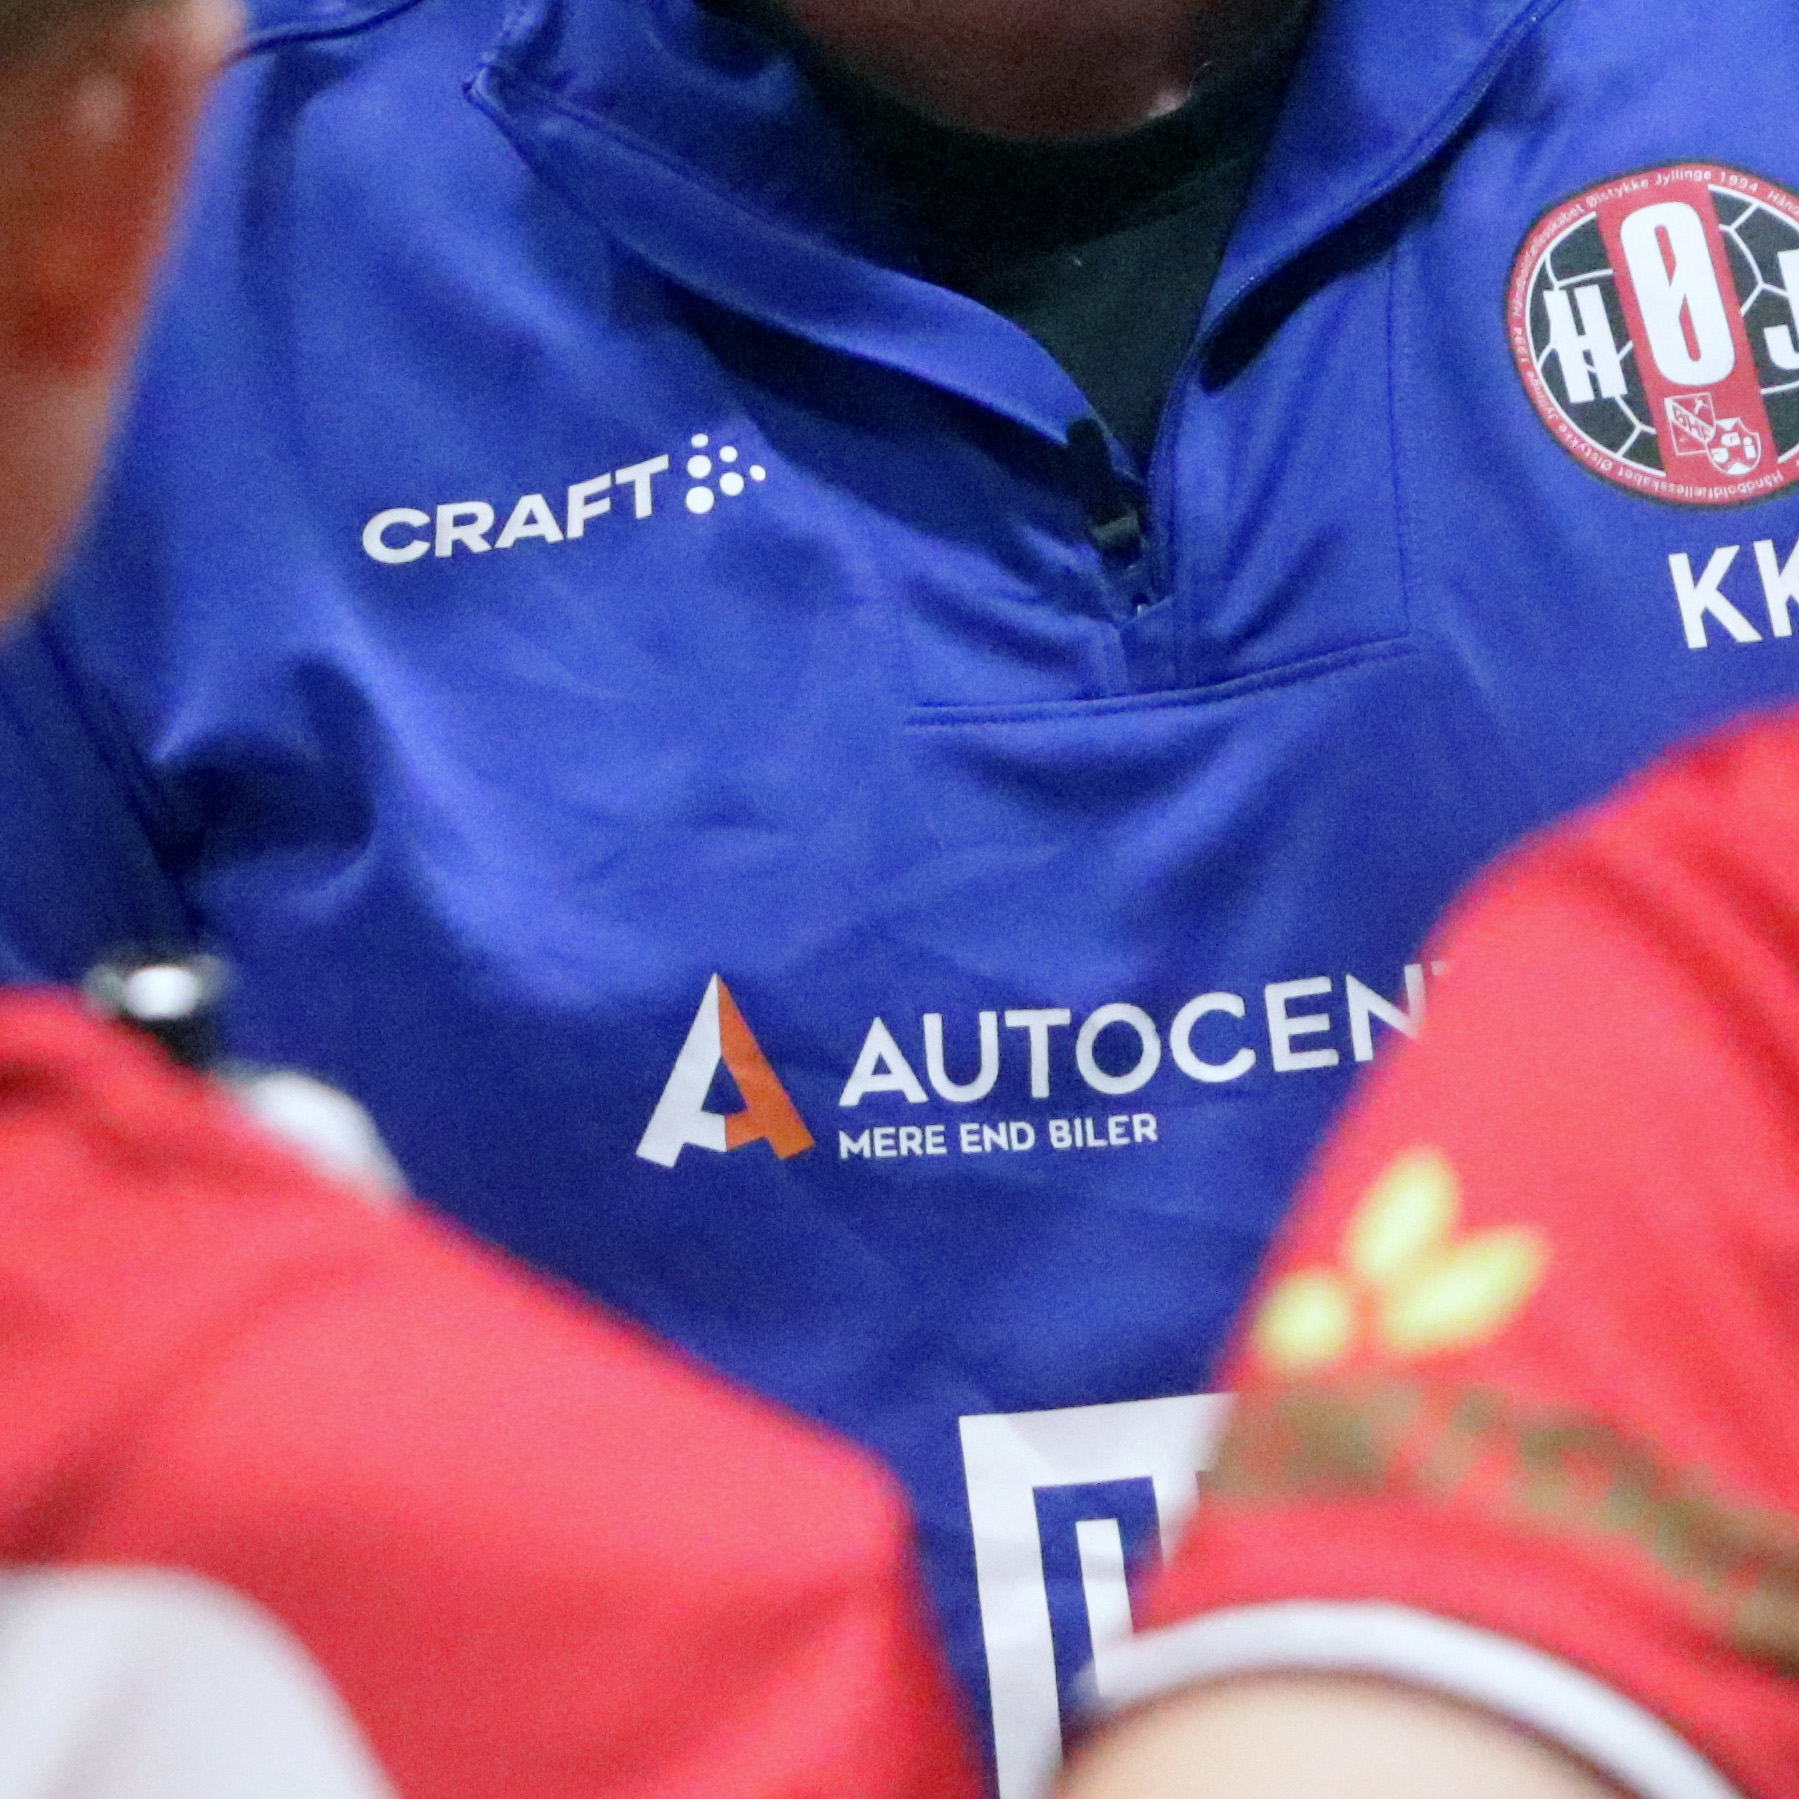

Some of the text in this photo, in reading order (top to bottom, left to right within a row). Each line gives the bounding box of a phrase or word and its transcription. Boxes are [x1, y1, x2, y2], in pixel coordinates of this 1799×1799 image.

[1585, 176, 1650, 210] Ølstykke
[1654, 167, 1712, 186] Jyllinge
[1720, 170, 1760, 194] 1994
[1558, 422, 1615, 473] Ølstykke
[362, 454, 670, 564] CRAFT
[1617, 469, 1785, 500] Håndboldfællesskabet
[838, 963, 1448, 1107] AUTOCEN
[838, 1111, 1159, 1160] MERE END BILER
